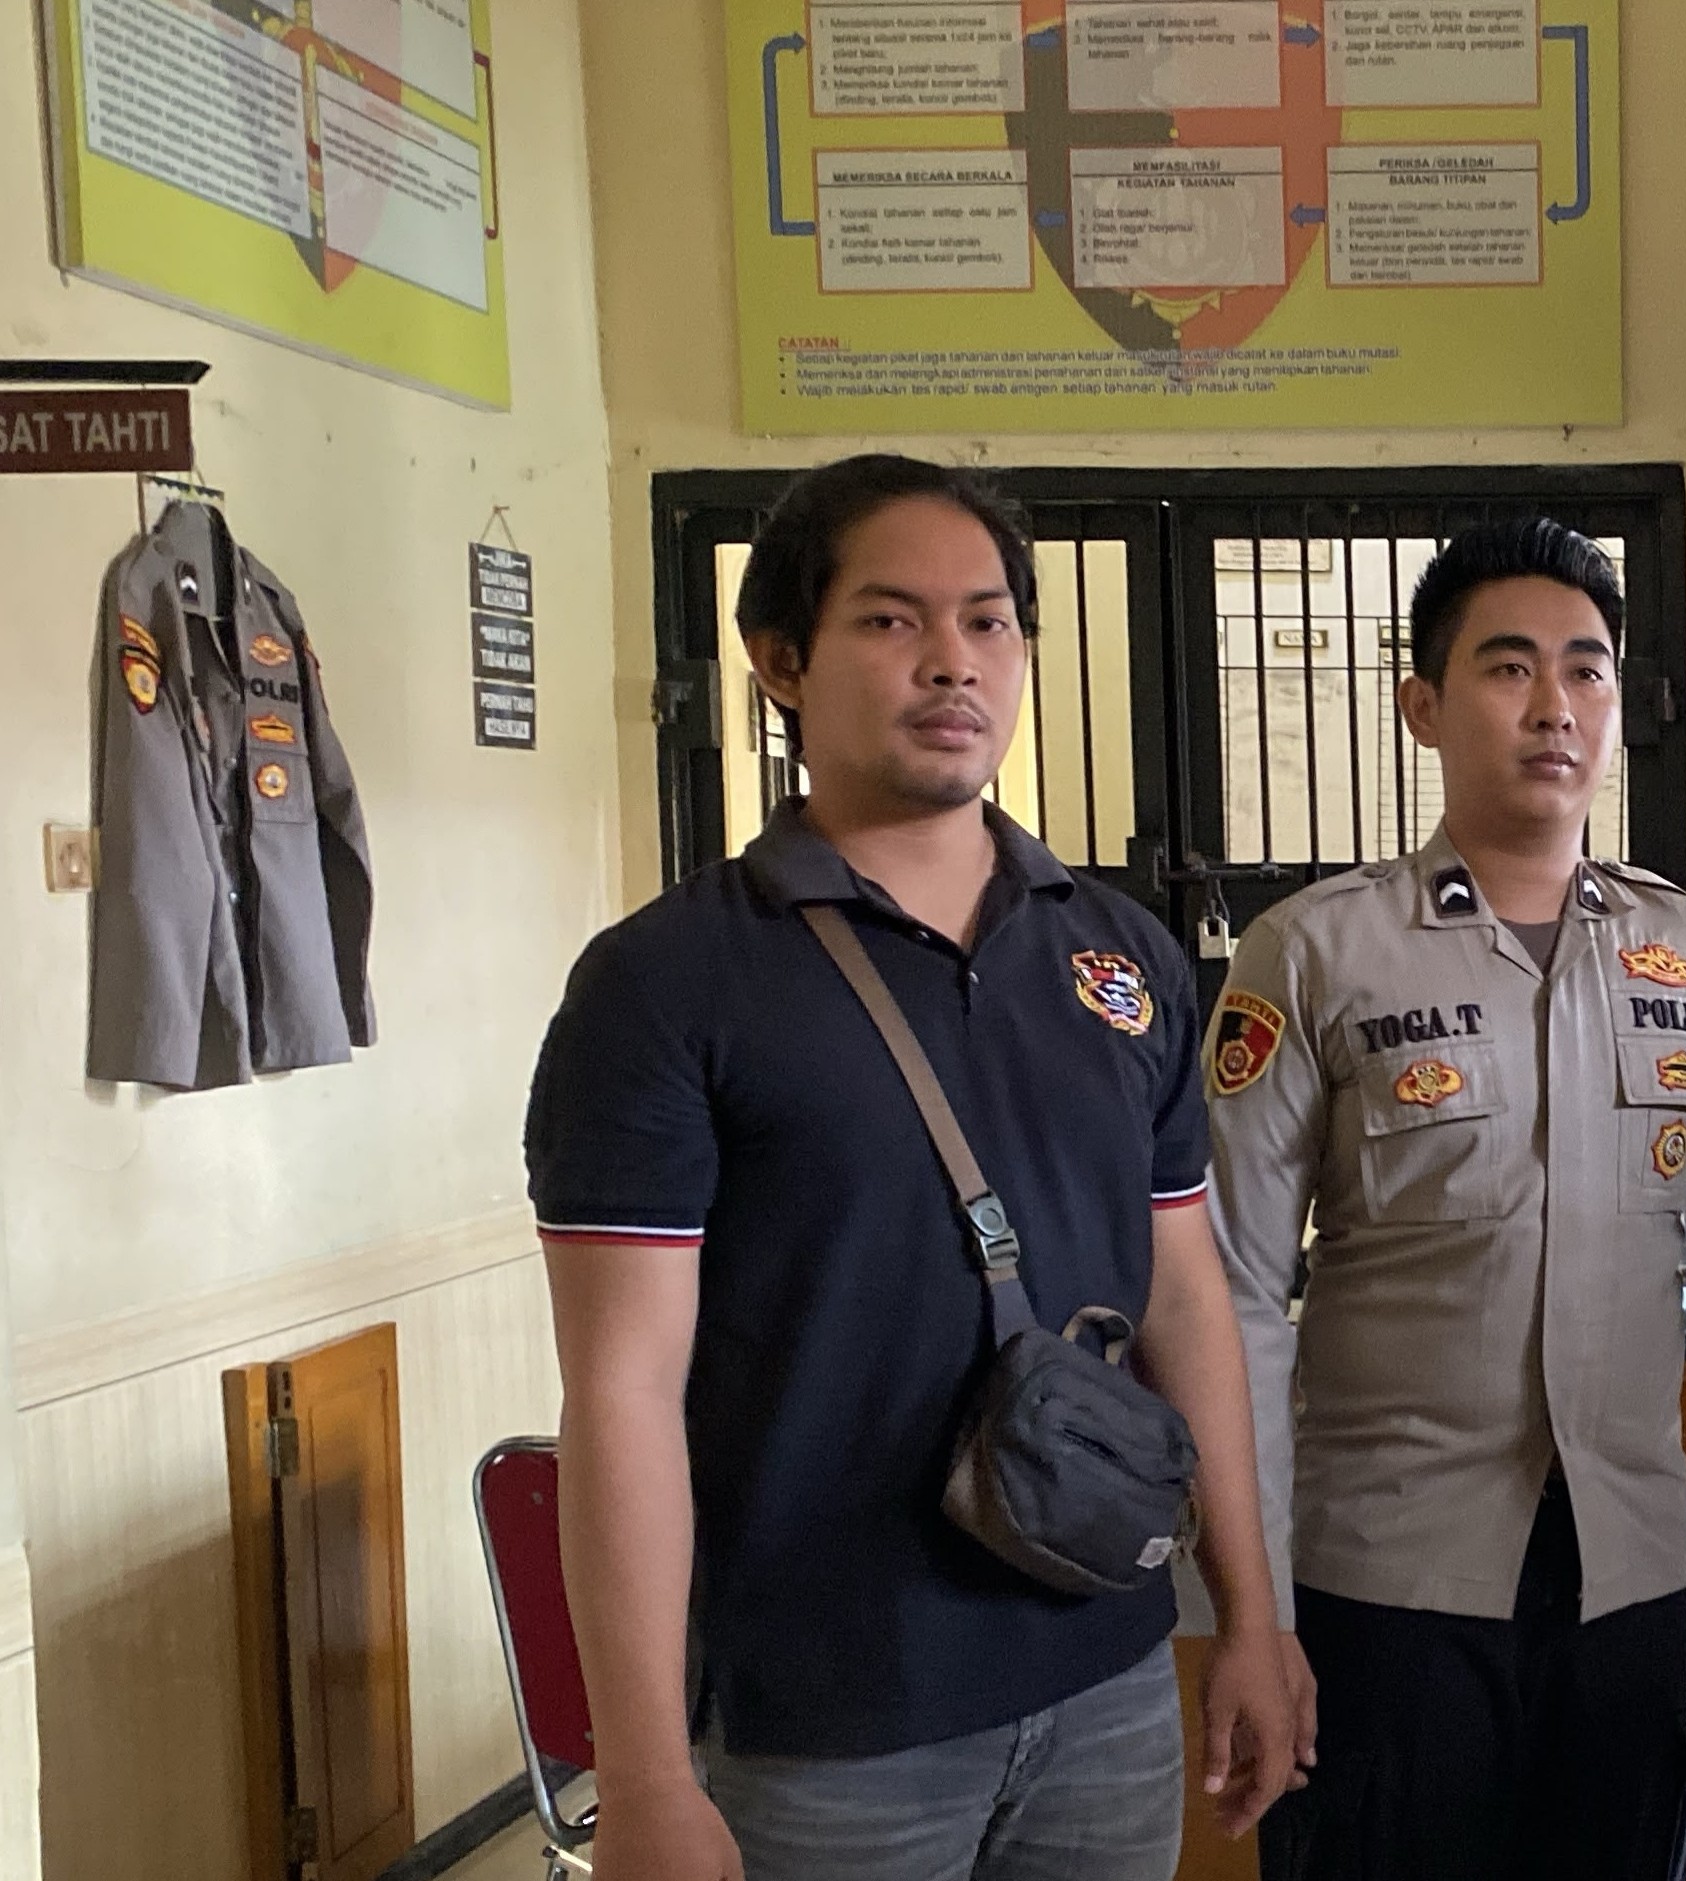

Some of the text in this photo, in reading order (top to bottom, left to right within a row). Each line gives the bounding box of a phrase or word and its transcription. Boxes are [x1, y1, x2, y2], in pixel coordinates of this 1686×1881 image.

[1379, 159, 1429, 168] PERIKSA
[833, 171, 1012, 182] MEMERIKSA SECARA BERKALA
[1117, 178, 1235, 188] KEGIATAN TAHANAN
[1389, 175, 1486, 185] BARANG TITIPAN
[778, 336, 839, 349] CATATAN
[836, 352, 888, 365] kegiatan
[949, 351, 998, 362] tahanan
[1026, 351, 1075, 362] tahanan
[1078, 350, 1114, 361] keluar
[1270, 349, 1284, 360] ke
[1288, 348, 1324, 360] dalam
[1326, 347, 1355, 359] buku
[865, 369, 887, 379] dan
[961, 367, 1031, 379] administrasi
[1034, 367, 1102, 379] penahanan
[1221, 366, 1250, 378] yang
[1253, 365, 1319, 378] menitipkan
[798, 384, 832, 399] Wajib
[836, 384, 906, 396] melakukan
[912, 384, 930, 395] tes
[974, 383, 1007, 394] swab
[1010, 383, 1058, 398] antigen
[1062, 383, 1101, 396] setiap
[1104, 382, 1156, 394] tahanan
[1161, 383, 1192, 396] yang
[1197, 381, 1239, 393] masuk
[64, 410, 170, 452] TAHTI
[1356, 1004, 1482, 1054] YOGA.T
